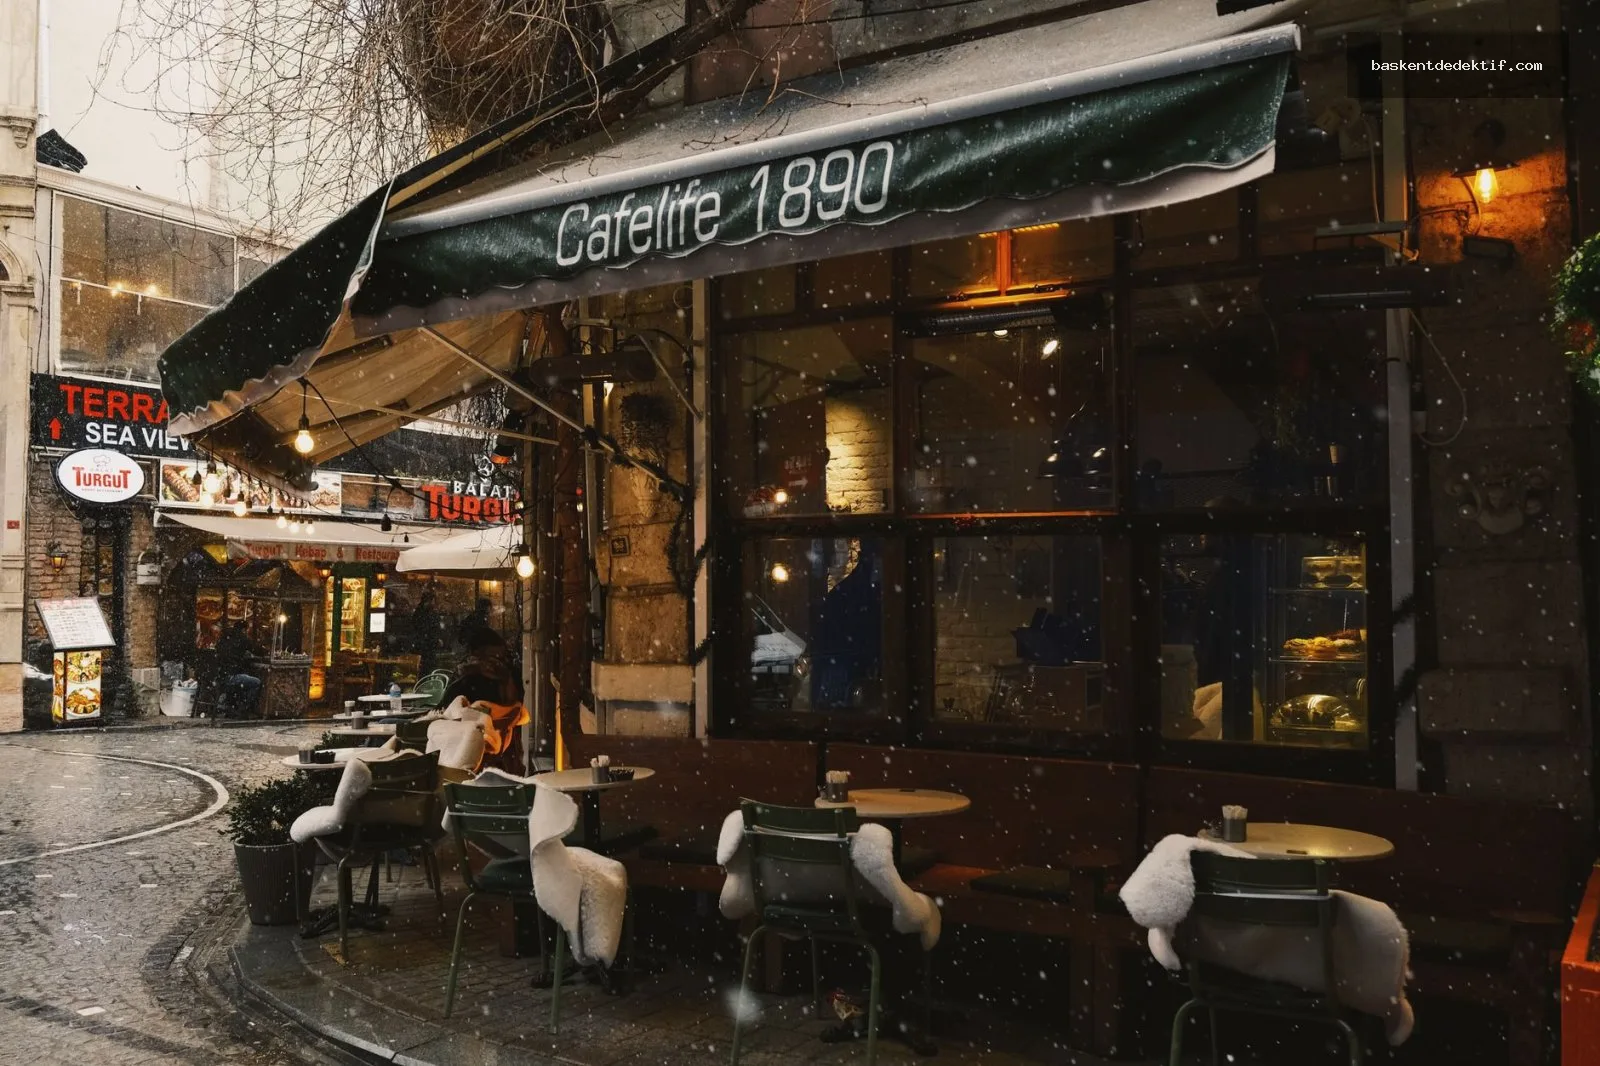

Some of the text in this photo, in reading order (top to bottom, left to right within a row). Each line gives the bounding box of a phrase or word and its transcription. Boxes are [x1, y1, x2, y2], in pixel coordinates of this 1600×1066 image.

[556, 140, 895, 267] Cafelife 1890
[85, 421, 136, 447] SEA
[421, 484, 522, 524] TURGU
[453, 480, 512, 499] BALAT
